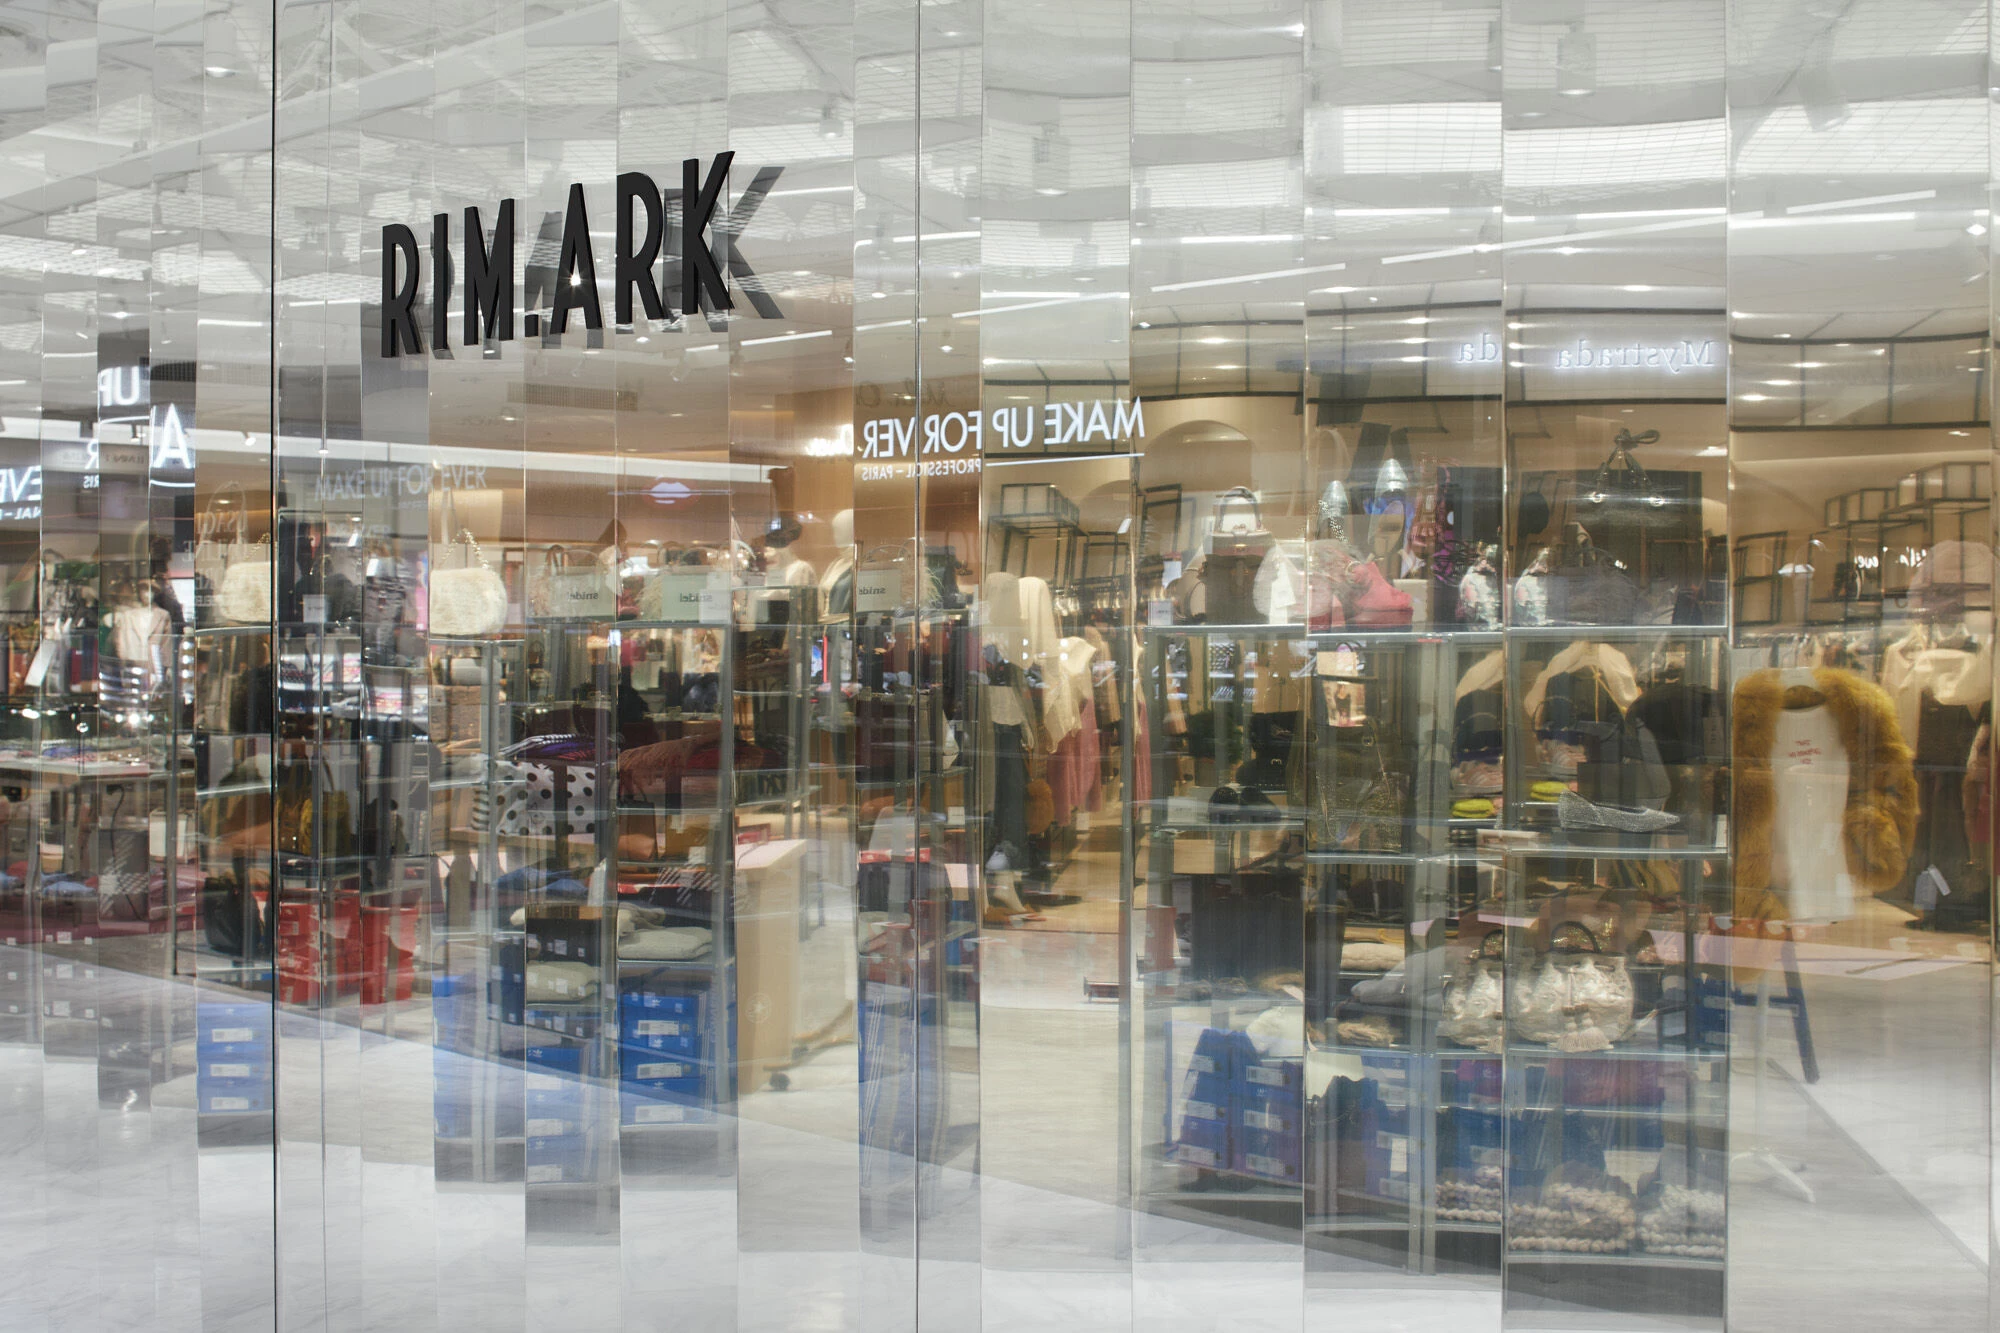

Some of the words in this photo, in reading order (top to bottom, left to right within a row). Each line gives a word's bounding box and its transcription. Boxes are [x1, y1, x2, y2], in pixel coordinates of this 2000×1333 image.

[381, 150, 736, 358] RIMARK
[314, 468, 366, 502] MAKE
[370, 467, 393, 499] UP
[398, 464, 434, 496] FOR
[440, 463, 488, 493] EVER
